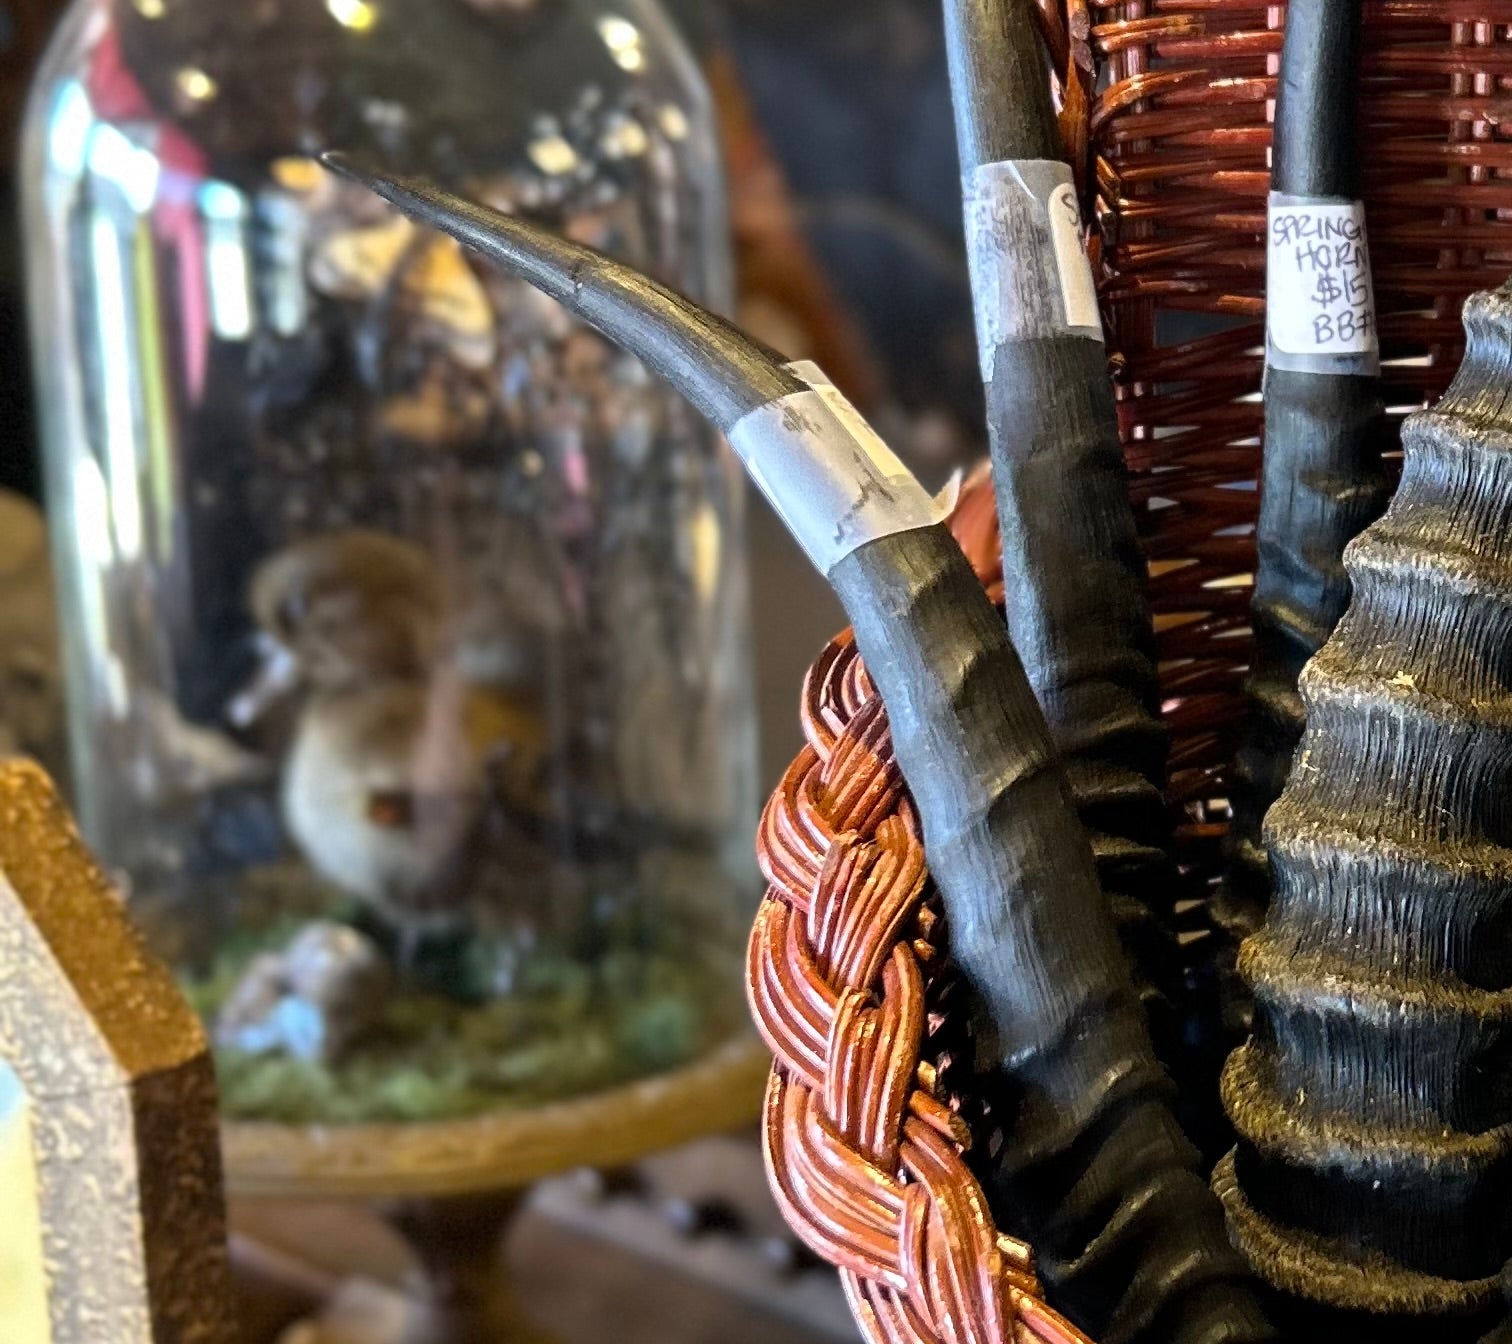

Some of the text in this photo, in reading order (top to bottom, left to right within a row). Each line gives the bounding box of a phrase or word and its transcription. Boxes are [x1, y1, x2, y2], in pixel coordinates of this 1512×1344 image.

[1273, 214, 1367, 246] SPRING
[1296, 240, 1367, 272] HORN
[1312, 269, 1369, 309] $15
